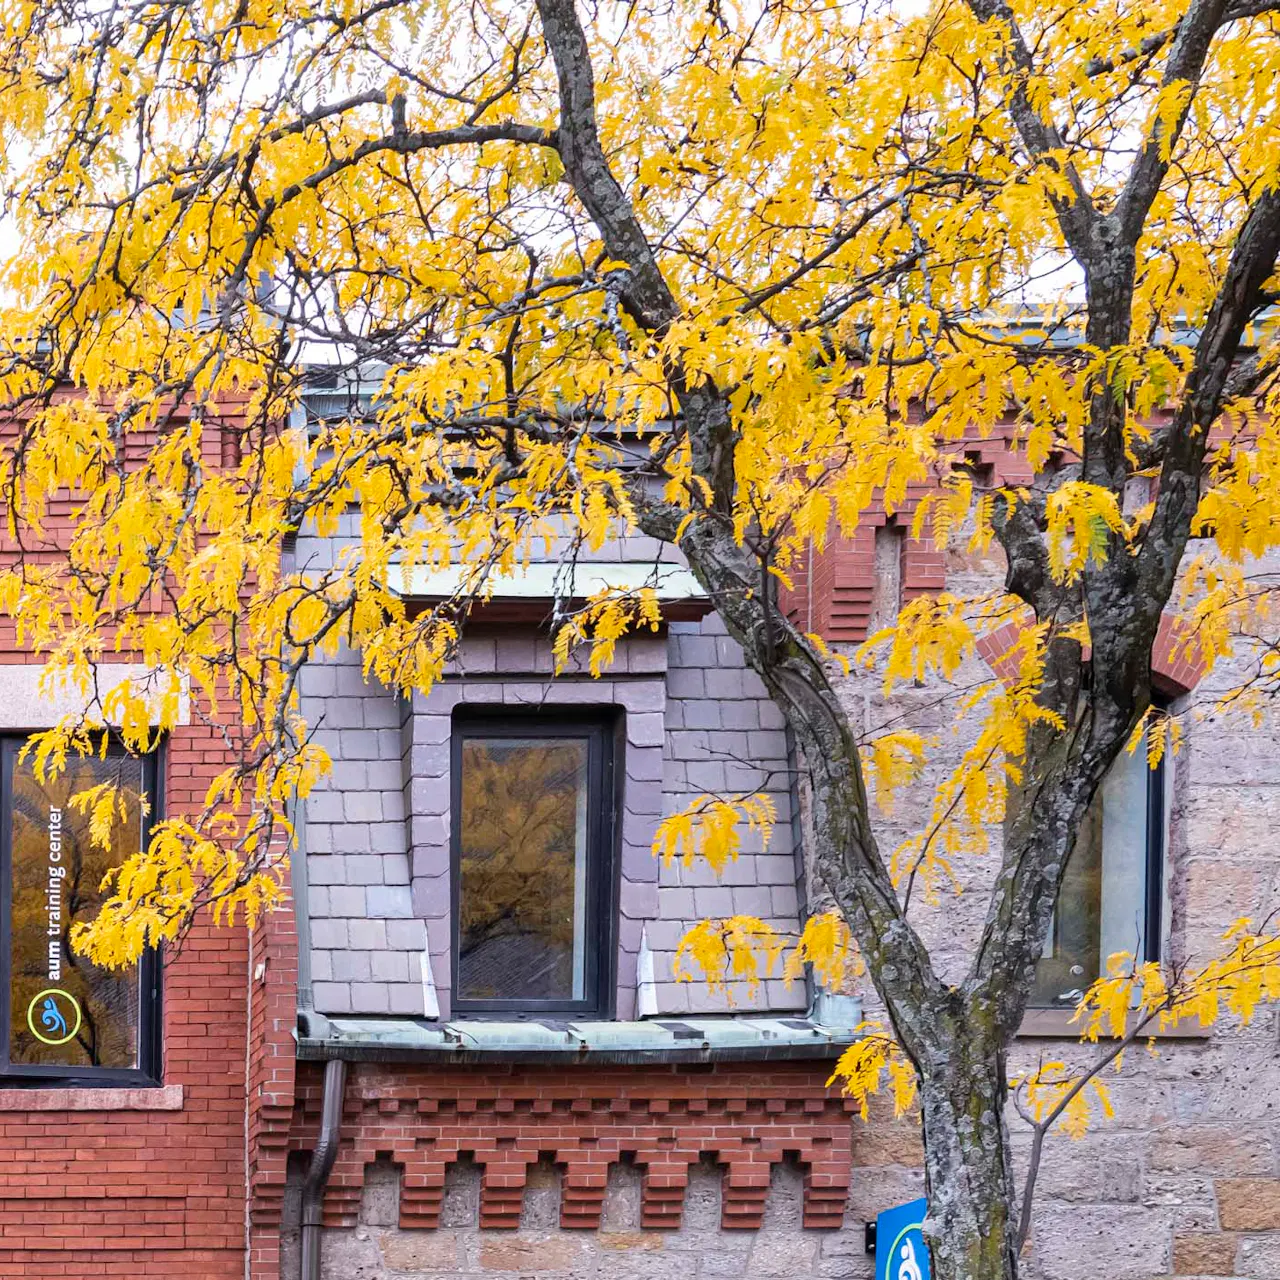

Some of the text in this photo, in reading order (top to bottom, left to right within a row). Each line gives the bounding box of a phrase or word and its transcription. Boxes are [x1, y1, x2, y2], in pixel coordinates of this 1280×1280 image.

[44, 805, 66, 980] aum training center
